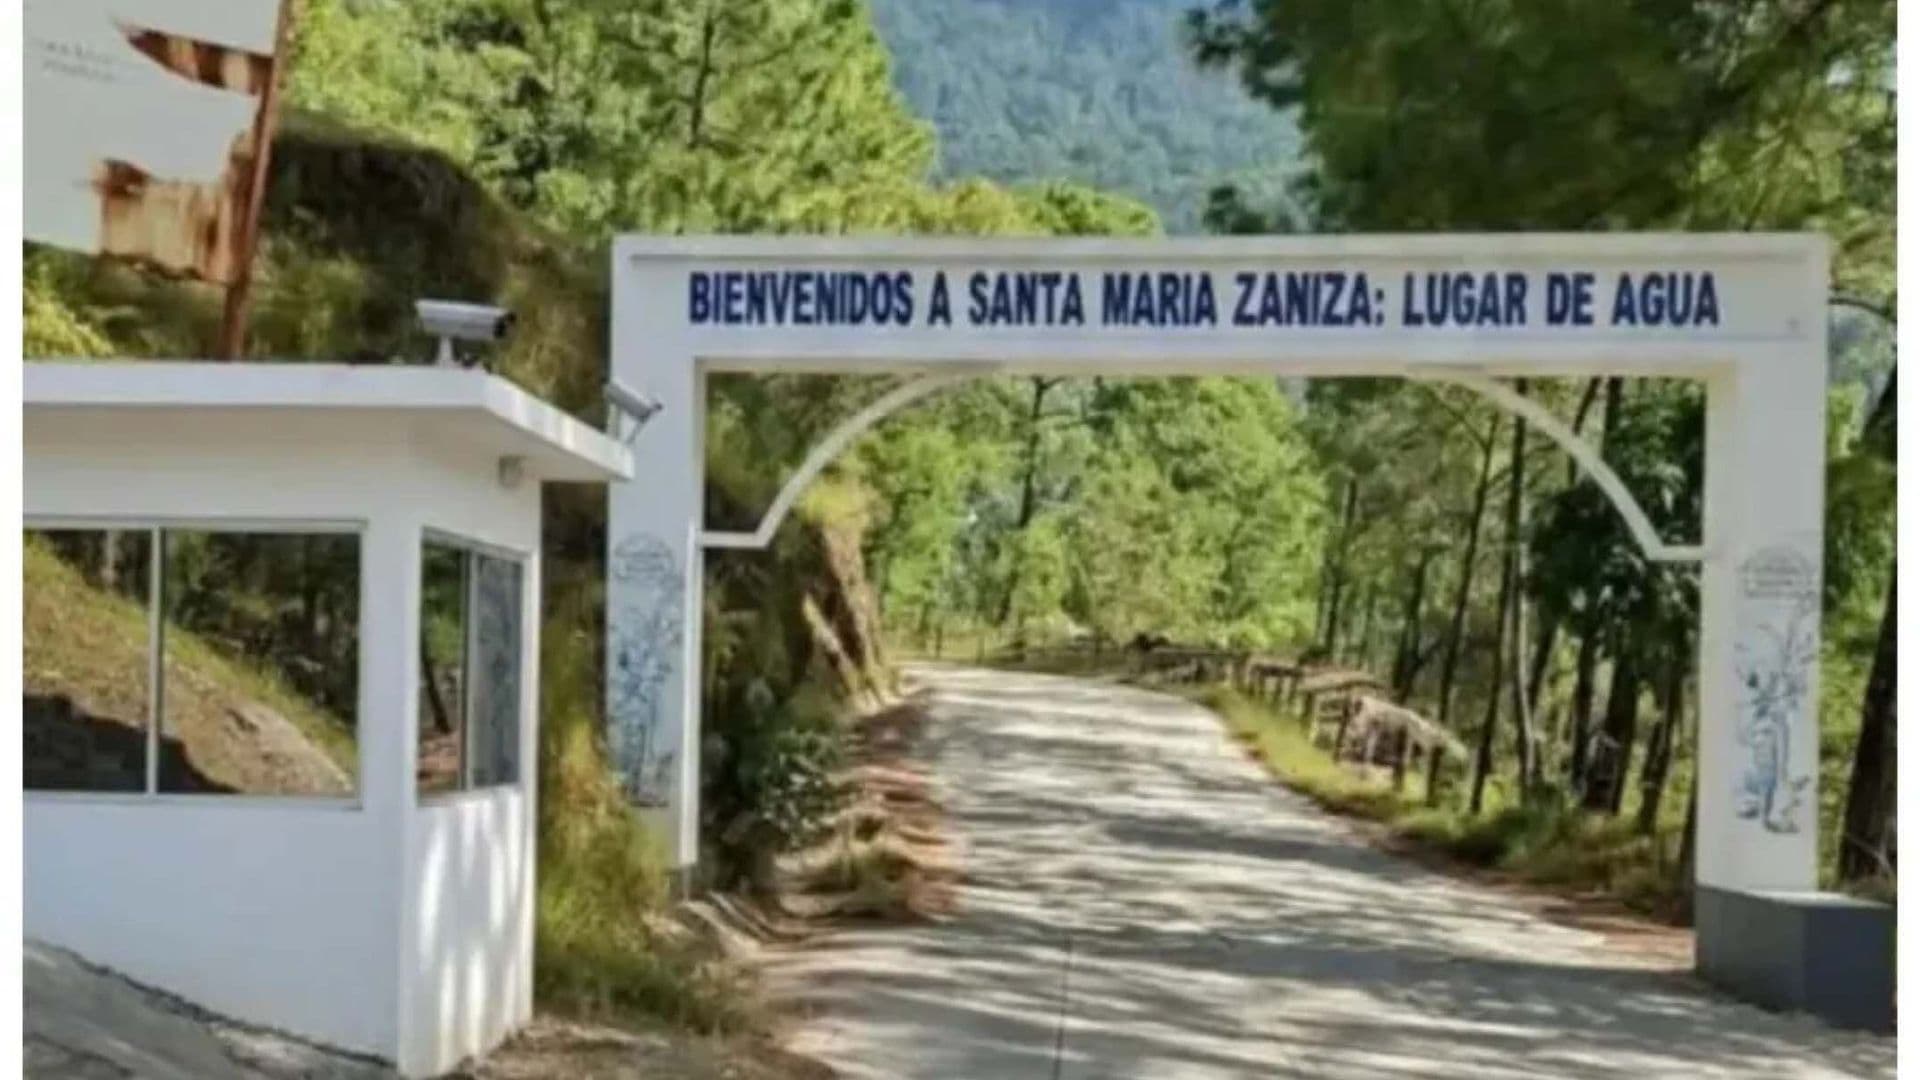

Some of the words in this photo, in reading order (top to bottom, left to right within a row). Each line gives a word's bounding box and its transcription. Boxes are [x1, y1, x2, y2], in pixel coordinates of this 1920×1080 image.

[688, 271, 914, 326] BIENVENIDOS
[927, 271, 953, 326] A
[969, 272, 1086, 327] SANTA
[1102, 272, 1217, 327] MARIA
[1233, 272, 1385, 327] ZANIZA:
[1402, 272, 1528, 327] LUGAR
[1546, 272, 1596, 327] DE
[1611, 272, 1720, 328] AGUA
